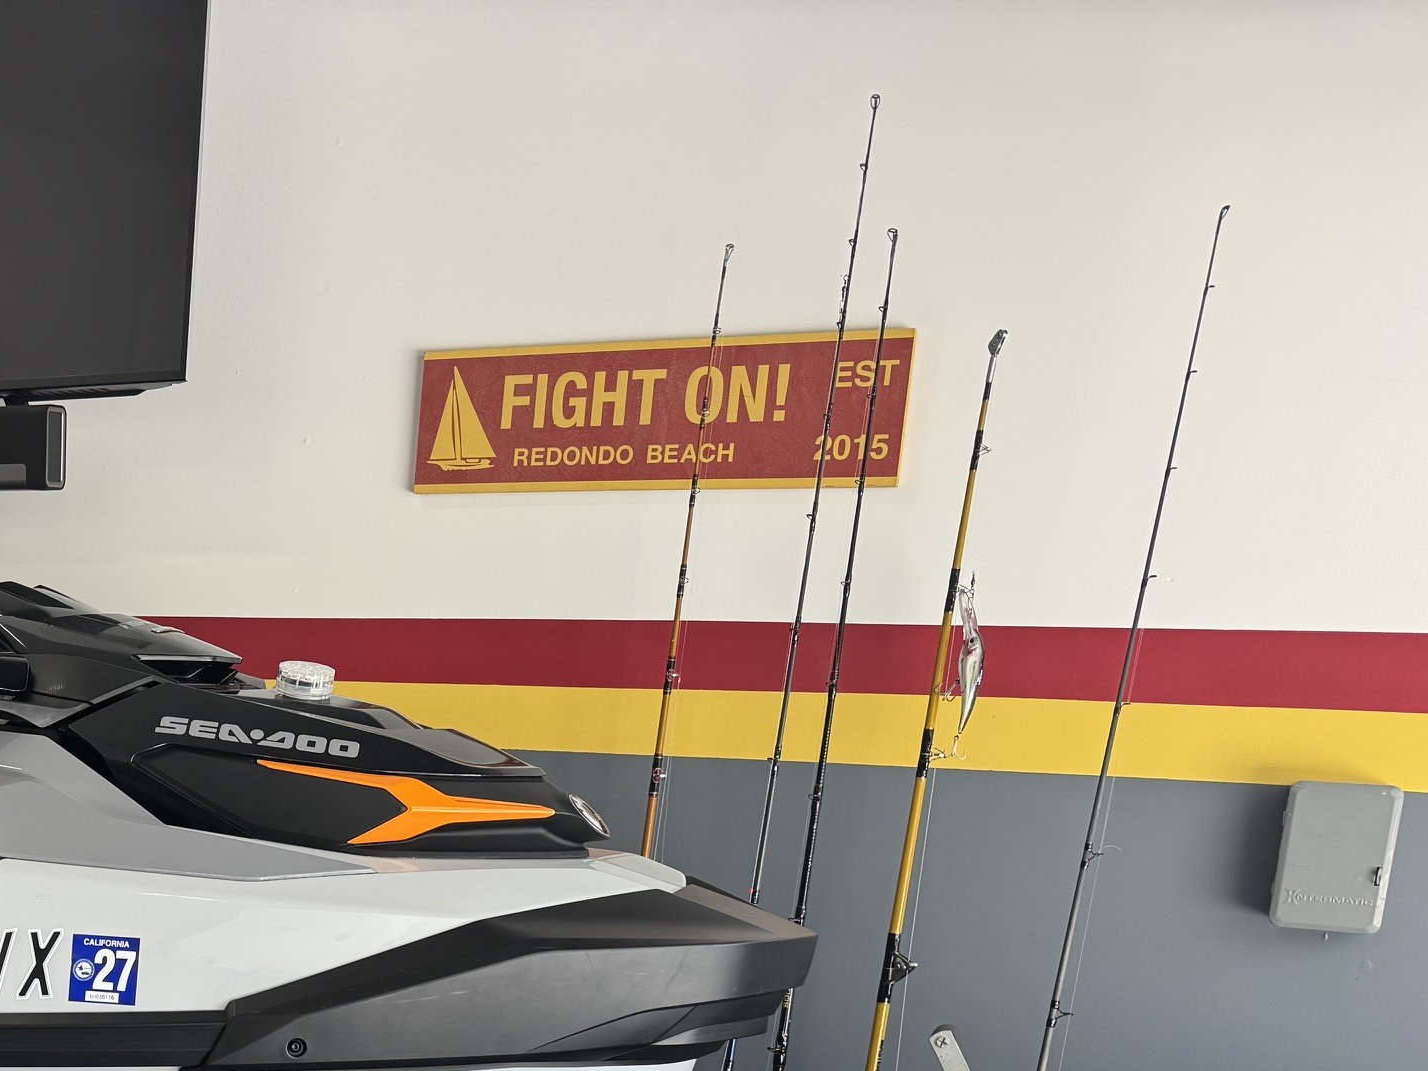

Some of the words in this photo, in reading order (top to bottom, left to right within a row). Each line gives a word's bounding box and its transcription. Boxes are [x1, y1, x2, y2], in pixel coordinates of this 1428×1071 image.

[836, 359, 900, 388] EST
[500, 368, 667, 429] FIGHT
[684, 363, 791, 425] ON!
[513, 444, 634, 467] REDONDO
[646, 442, 735, 464] BEACH
[813, 433, 889, 461] 2015
[83, 937, 130, 949] CALIFORNIA
[92, 948, 137, 992] 27
